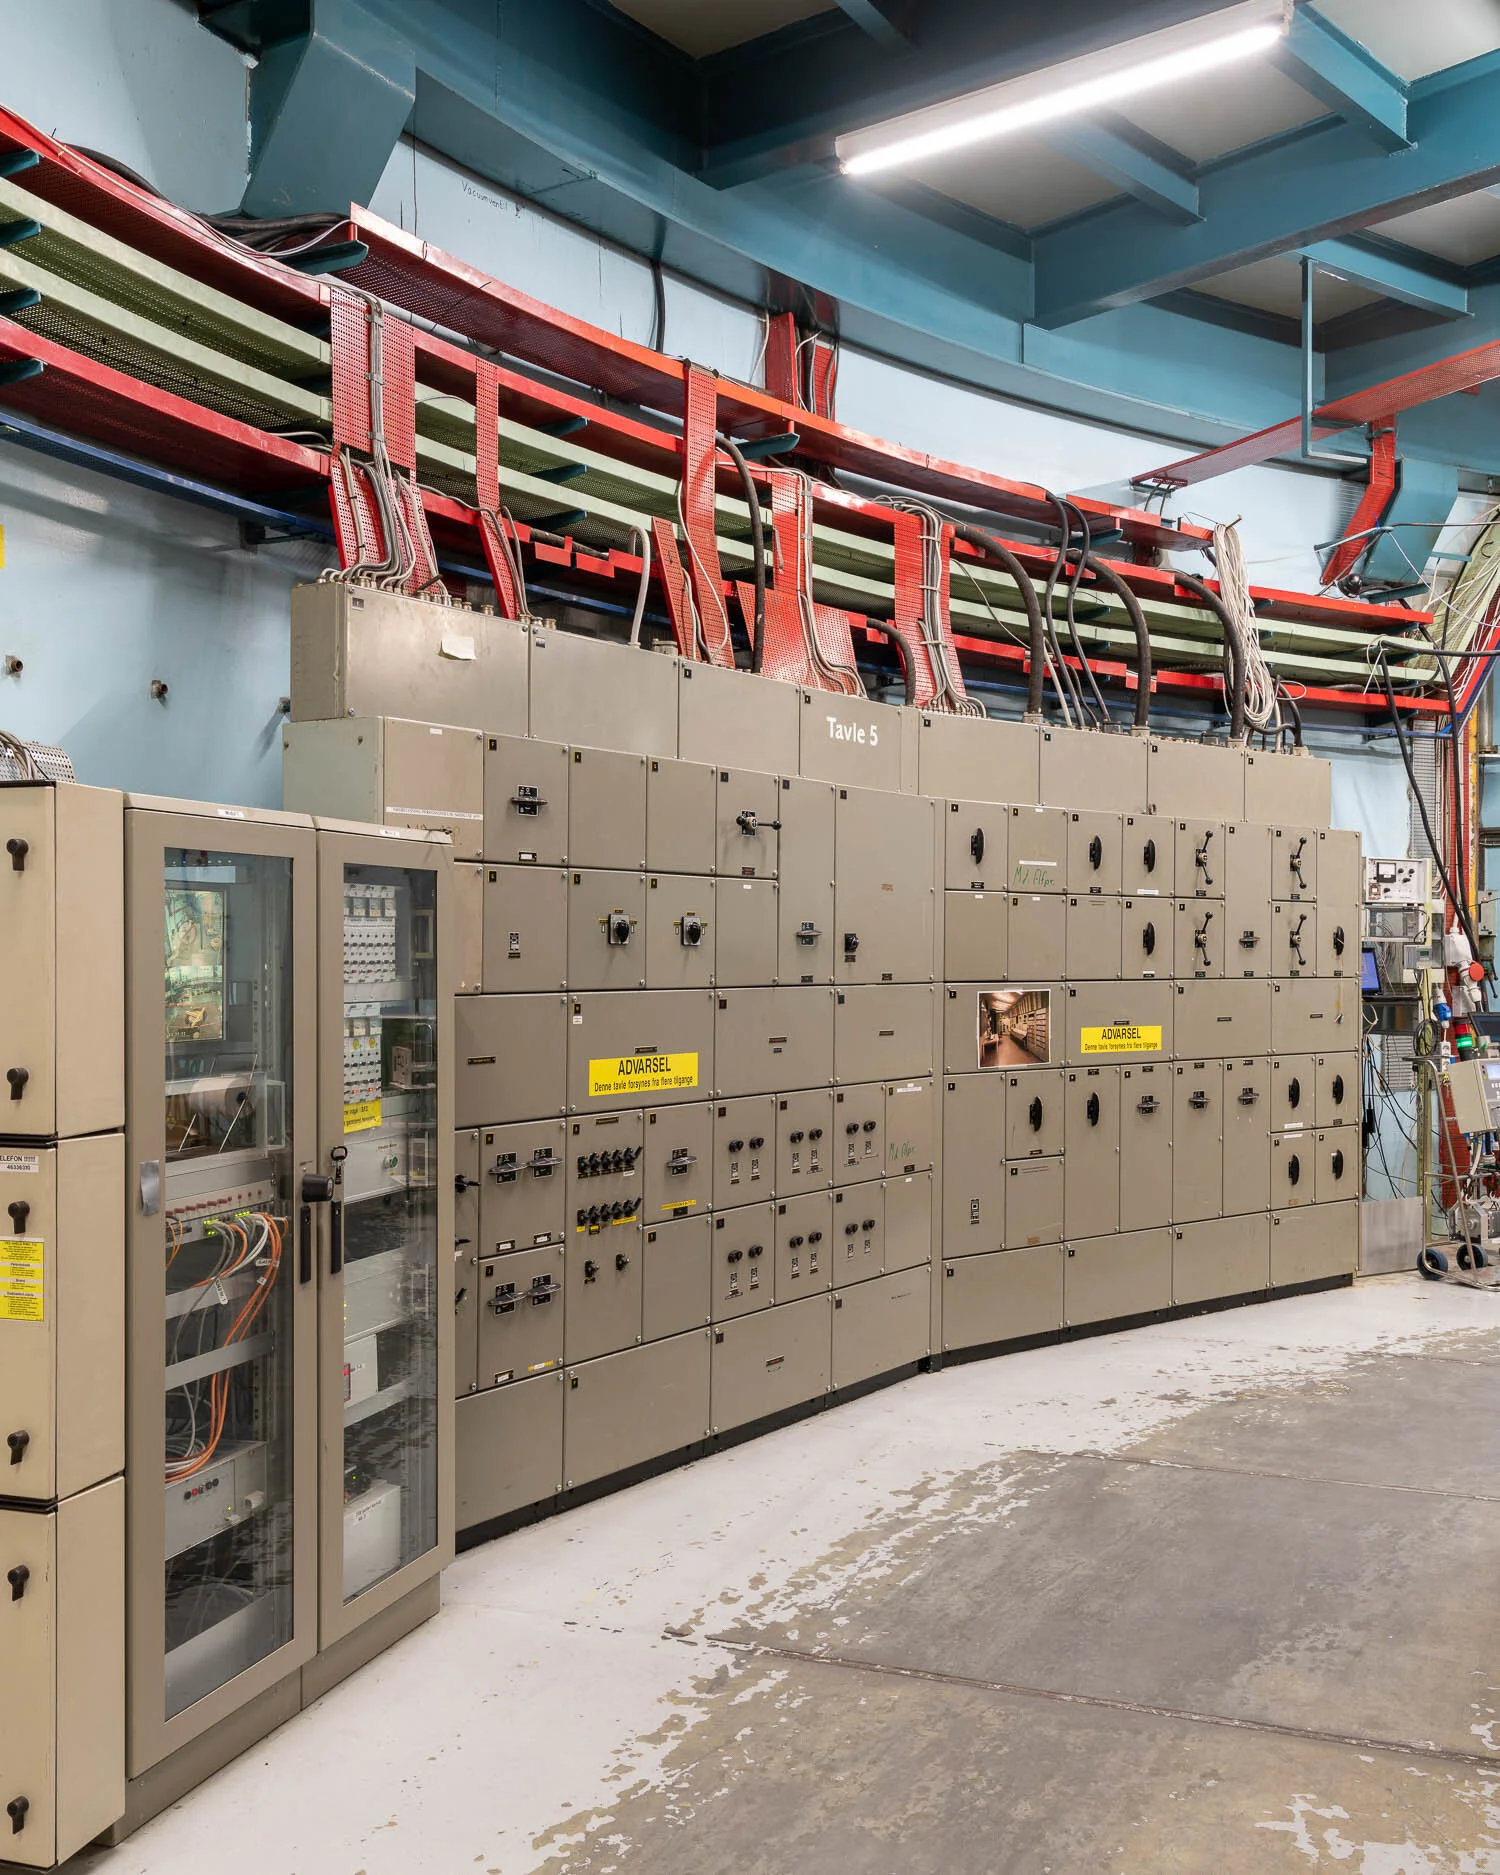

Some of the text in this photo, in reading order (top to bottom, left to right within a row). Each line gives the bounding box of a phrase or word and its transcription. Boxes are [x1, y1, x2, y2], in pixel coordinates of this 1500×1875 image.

[826, 715, 879, 746] Tavle 5
[1101, 1027, 1142, 1040] ADVARSEL
[1084, 1043, 1098, 1051] Denne
[1109, 1042, 1126, 1051] forsynes
[1143, 1041, 1158, 1050] tilgange
[617, 1056, 672, 1076] ADVARSEL
[594, 1075, 694, 1093] Denne tavle forsynes fra flere tilgange
